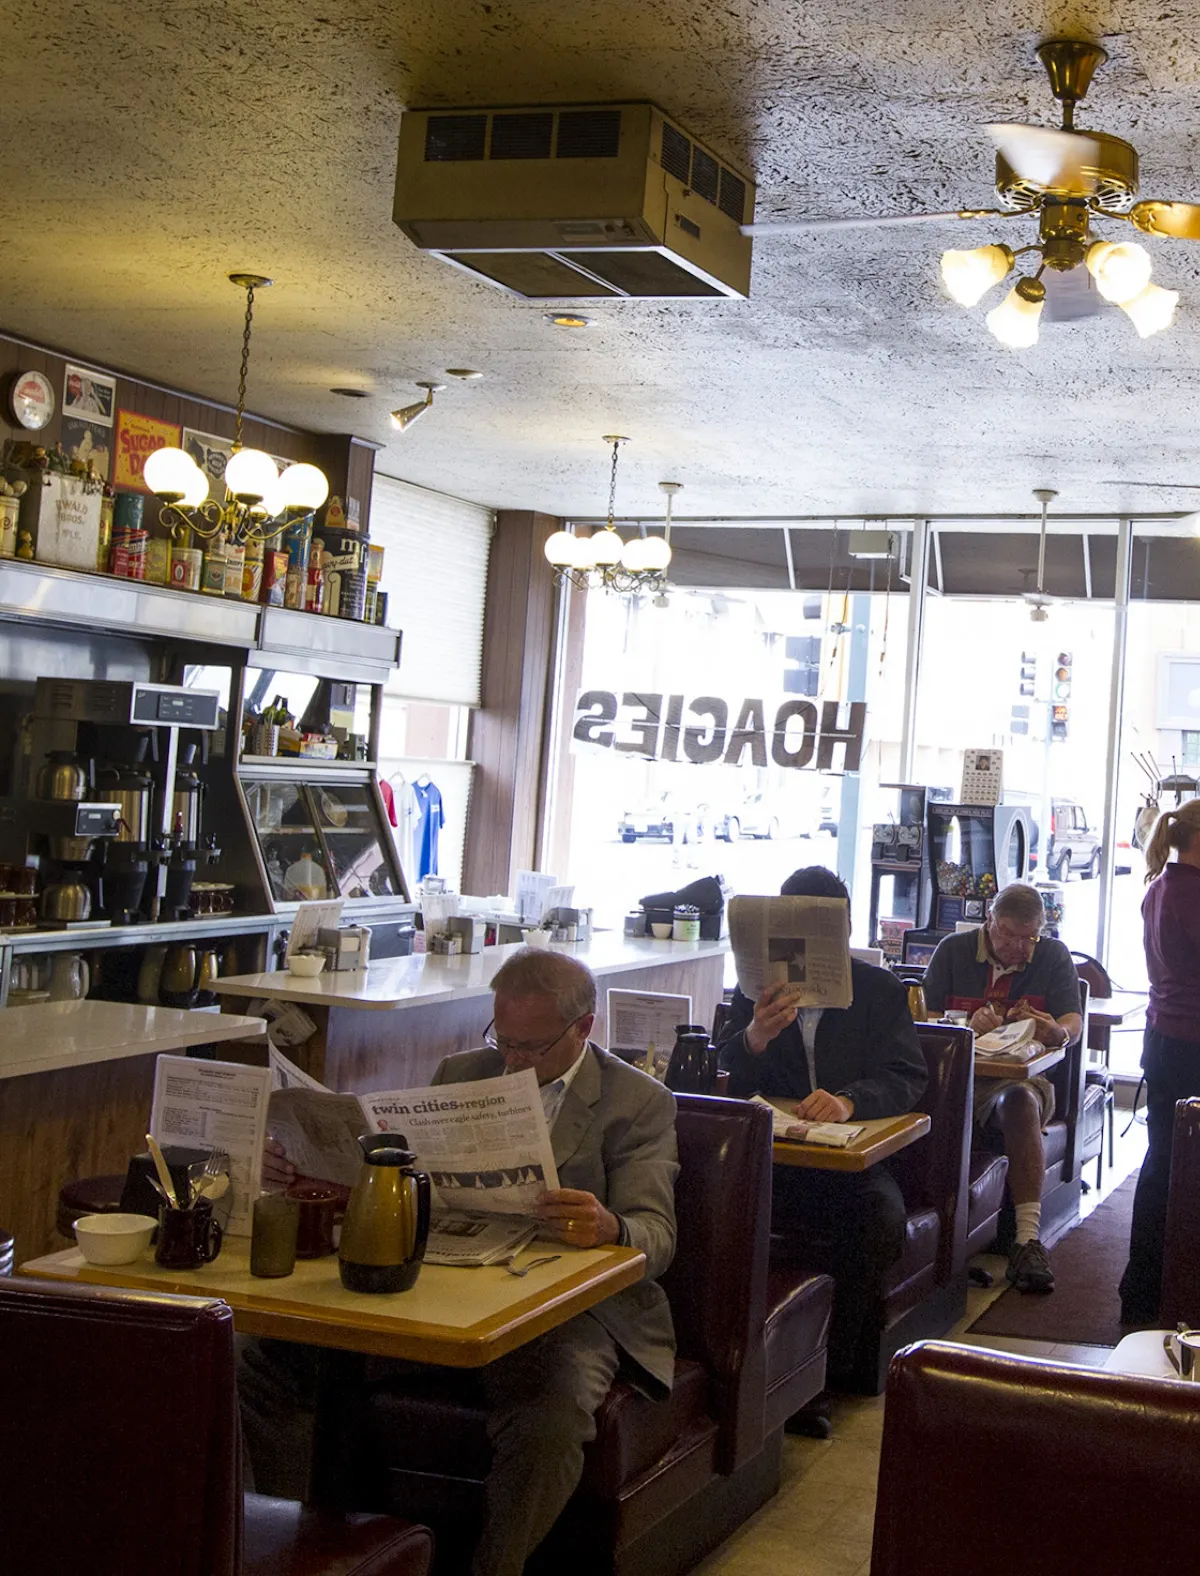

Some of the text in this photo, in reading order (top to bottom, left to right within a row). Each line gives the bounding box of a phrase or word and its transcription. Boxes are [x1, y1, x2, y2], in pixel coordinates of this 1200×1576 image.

[372, 1102, 410, 1116] twin
[409, 1116, 431, 1127] Clash
[431, 1116, 449, 1126] over
[449, 1114, 471, 1126] eagle
